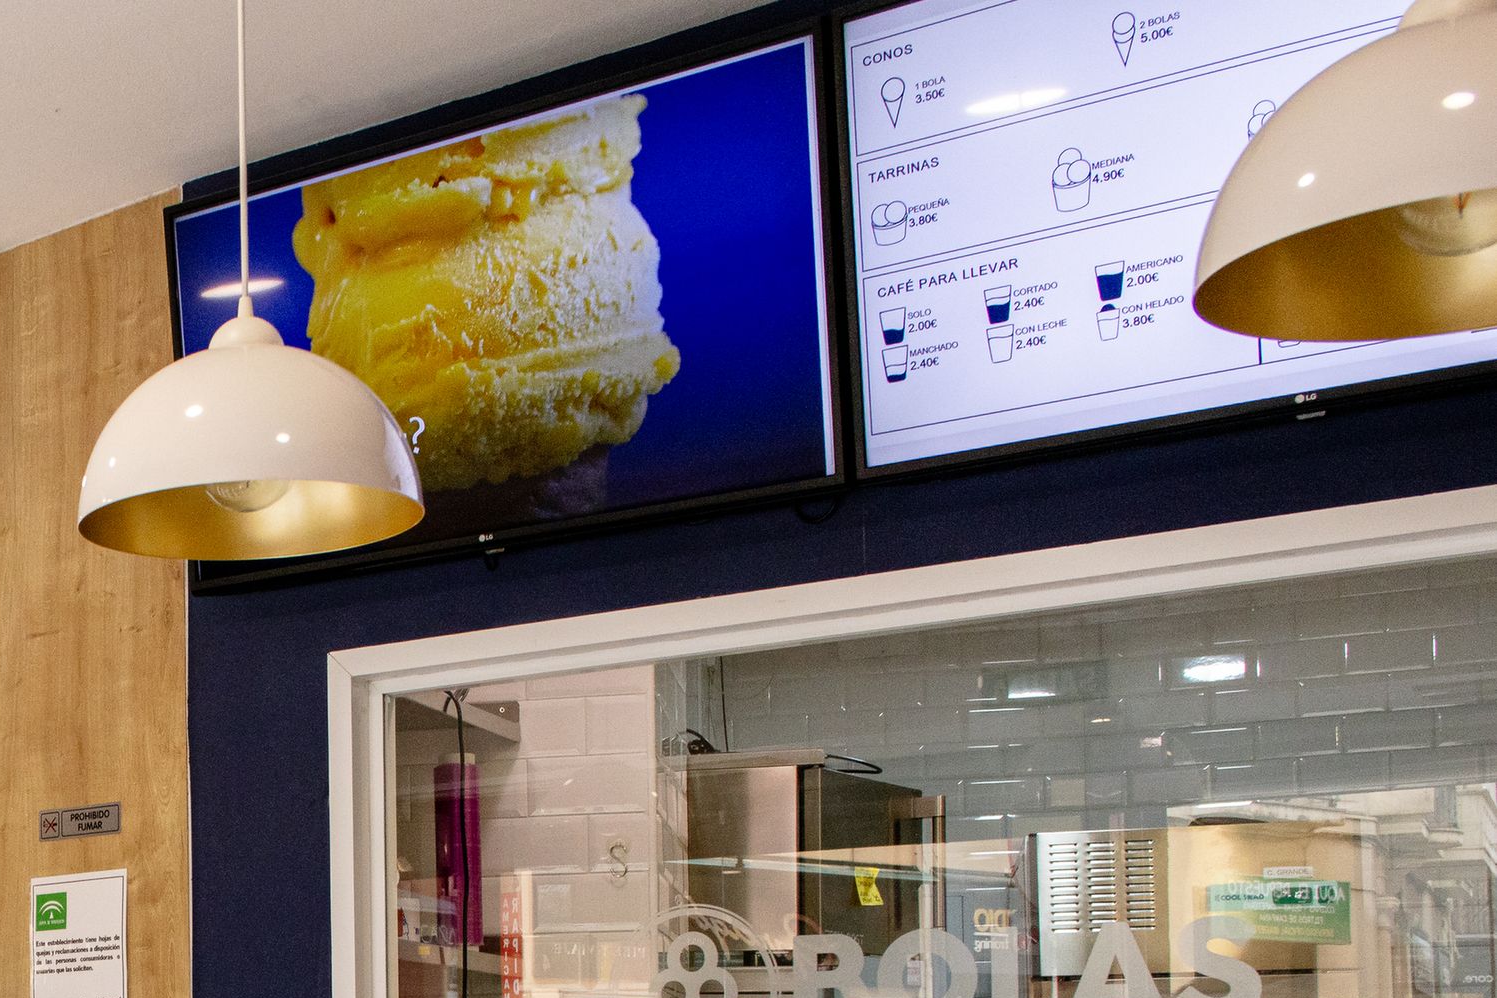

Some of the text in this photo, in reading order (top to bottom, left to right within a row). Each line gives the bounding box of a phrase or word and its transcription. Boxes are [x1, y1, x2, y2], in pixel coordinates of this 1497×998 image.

[1139, 11, 1181, 29] 2 BOLAS
[1140, 26, 1174, 43] 5.00€
[862, 44, 913, 67] CONOS
[922, 76, 946, 89] BOLA
[915, 88, 945, 104] 3.50€
[868, 156, 940, 183] TARRINAS
[1091, 153, 1135, 170] MEDIANA
[1092, 168, 1125, 184] 4.90€
[908, 197, 950, 214] PEQUEÑA
[908, 213, 938, 228] 3.80€
[1125, 254, 1184, 274] AMERICANO
[877, 258, 1019, 298] CAFÉ PARA LLEVAR
[1126, 272, 1159, 288] 2.00€
[1013, 281, 1058, 297] CORTADO
[1013, 296, 1045, 311] 2.40€
[1121, 295, 1185, 314] CON HELADO
[907, 308, 932, 320] SOLO
[1122, 313, 1155, 328] 3.80€
[908, 319, 937, 333] 2.00€
[1015, 318, 1067, 336] CON LECHE
[909, 341, 959, 358] MANCHADO
[1015, 335, 1046, 350] 2.40€
[910, 356, 940, 371] 2.40€
[70, 809, 110, 821] PROHIBIDO
[77, 821, 103, 832] FUMAR
